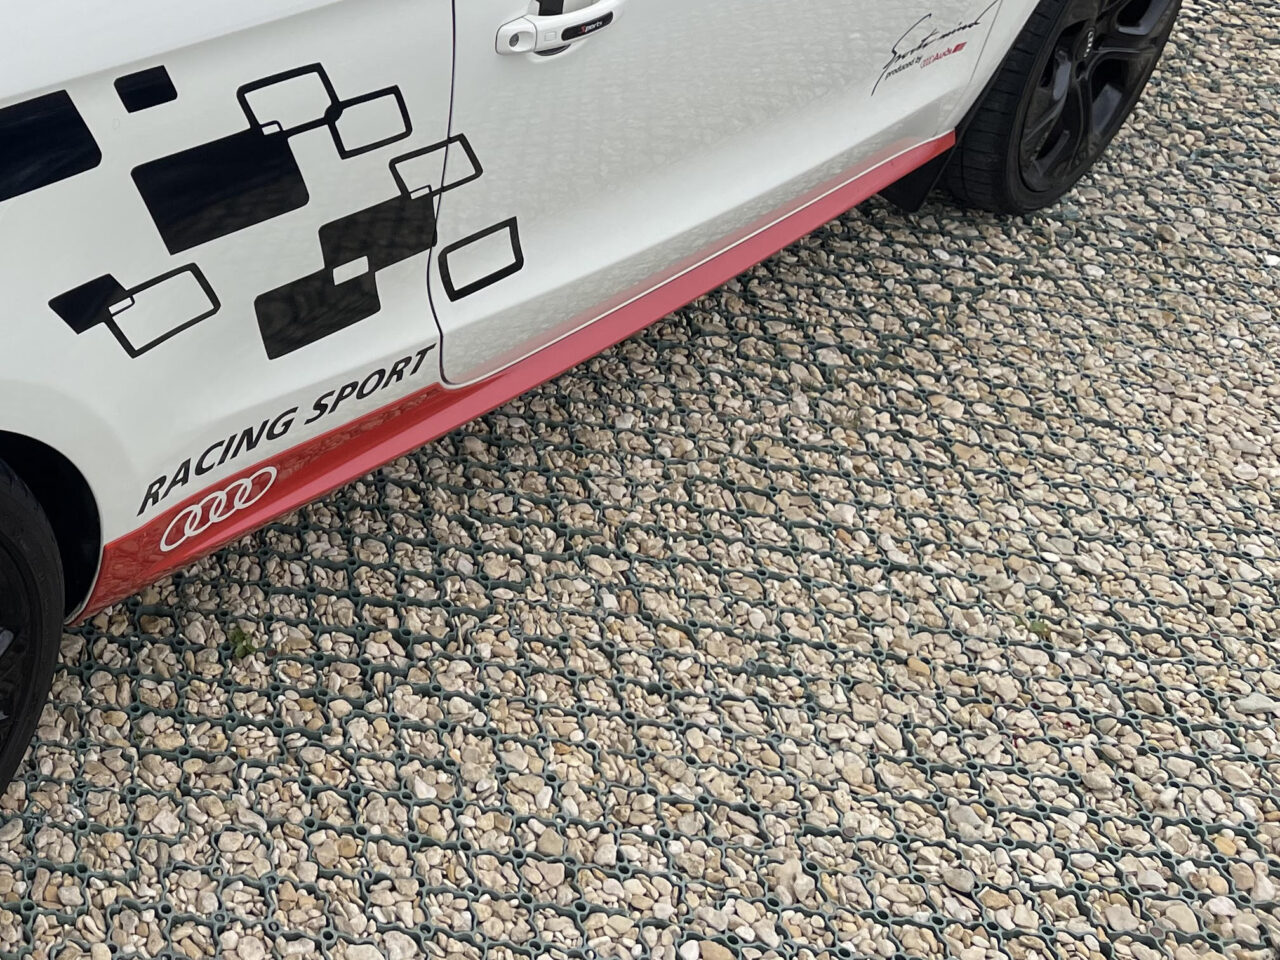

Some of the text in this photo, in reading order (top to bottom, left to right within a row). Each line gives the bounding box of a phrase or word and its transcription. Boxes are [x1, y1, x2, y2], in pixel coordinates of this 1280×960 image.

[931, 47, 953, 63] Audi
[136, 342, 438, 517] RACING SPORT
